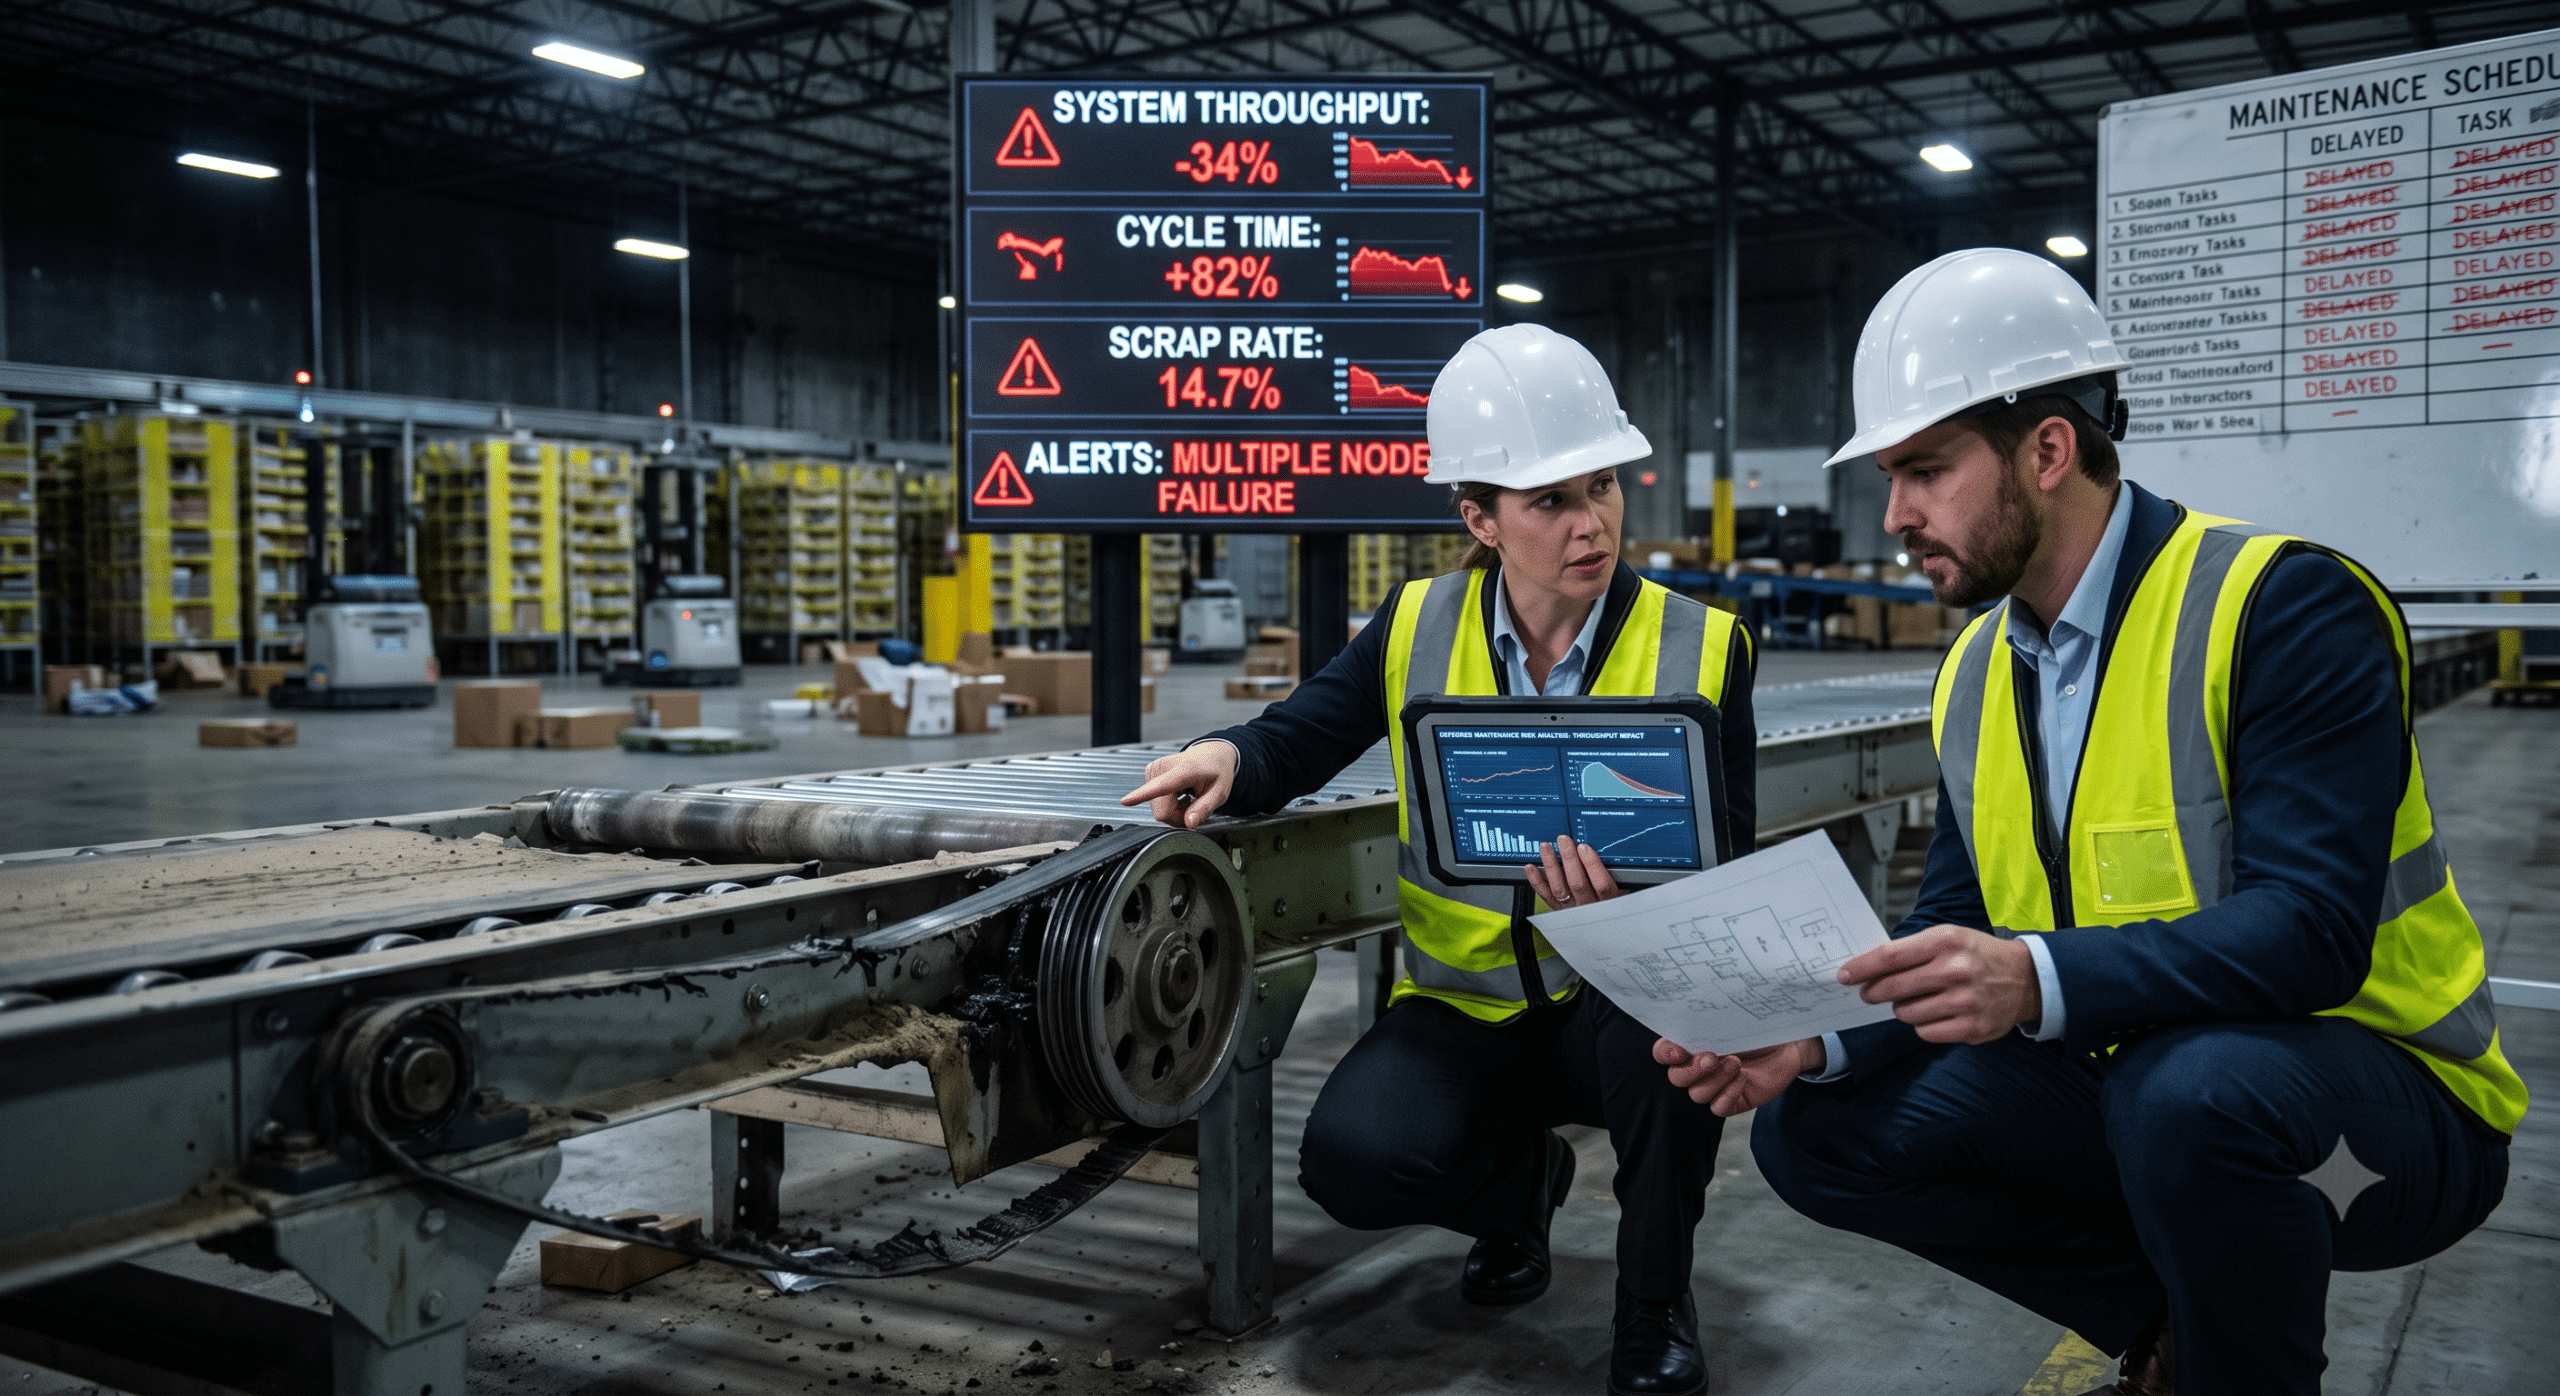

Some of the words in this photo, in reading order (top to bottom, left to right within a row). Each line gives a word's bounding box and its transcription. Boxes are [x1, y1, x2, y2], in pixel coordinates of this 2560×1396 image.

[1053, 90, 1187, 124] SYSTEM
[1195, 91, 1430, 124] THROUGHPUT:
[2230, 73, 2427, 130] MAINTENANCE
[2457, 107, 2513, 135] TASK
[2311, 125, 2404, 156] DELAYED
[2452, 139, 2555, 168] DELAYED
[1175, 141, 1279, 184] -34%
[2304, 161, 2394, 188] DELAYED
[2453, 168, 2555, 195] DELAYED
[2177, 189, 2218, 206] Tasks
[2304, 188, 2396, 214] DELAYED
[2453, 195, 2555, 223] DELAYED
[1117, 215, 1226, 248] CYCLE
[1234, 215, 1321, 248] TIME:
[2197, 211, 2237, 229] Tasks
[2303, 216, 2397, 240] DELAYED
[2206, 236, 2246, 252] Tasks
[2453, 224, 2555, 249] DELAYED
[2303, 241, 2396, 267] DELAYED
[2454, 251, 2554, 276] DELAYED
[1165, 256, 1279, 298] +82%
[2192, 262, 2224, 279] Task
[2304, 269, 2394, 294] DELAYED
[2220, 285, 2261, 300] Tasks
[2451, 278, 2555, 304] DELAYED
[2303, 293, 2396, 319] DELAYED
[2304, 321, 2397, 345] DELAYED
[2452, 308, 2554, 332] DELAYED
[1109, 326, 1221, 359] SCRAP
[1229, 326, 1323, 359] RATE:
[2205, 338, 2240, 353] Tasks
[2302, 348, 2398, 374] DELAYED
[1159, 366, 1281, 409] 14.7%
[2305, 375, 2398, 398] DELAYED
[1025, 441, 1164, 474] ALERTS:
[1172, 442, 1332, 474] MULTIPLE
[1341, 442, 1430, 474] NODE
[1159, 480, 1294, 514] FAILURE
